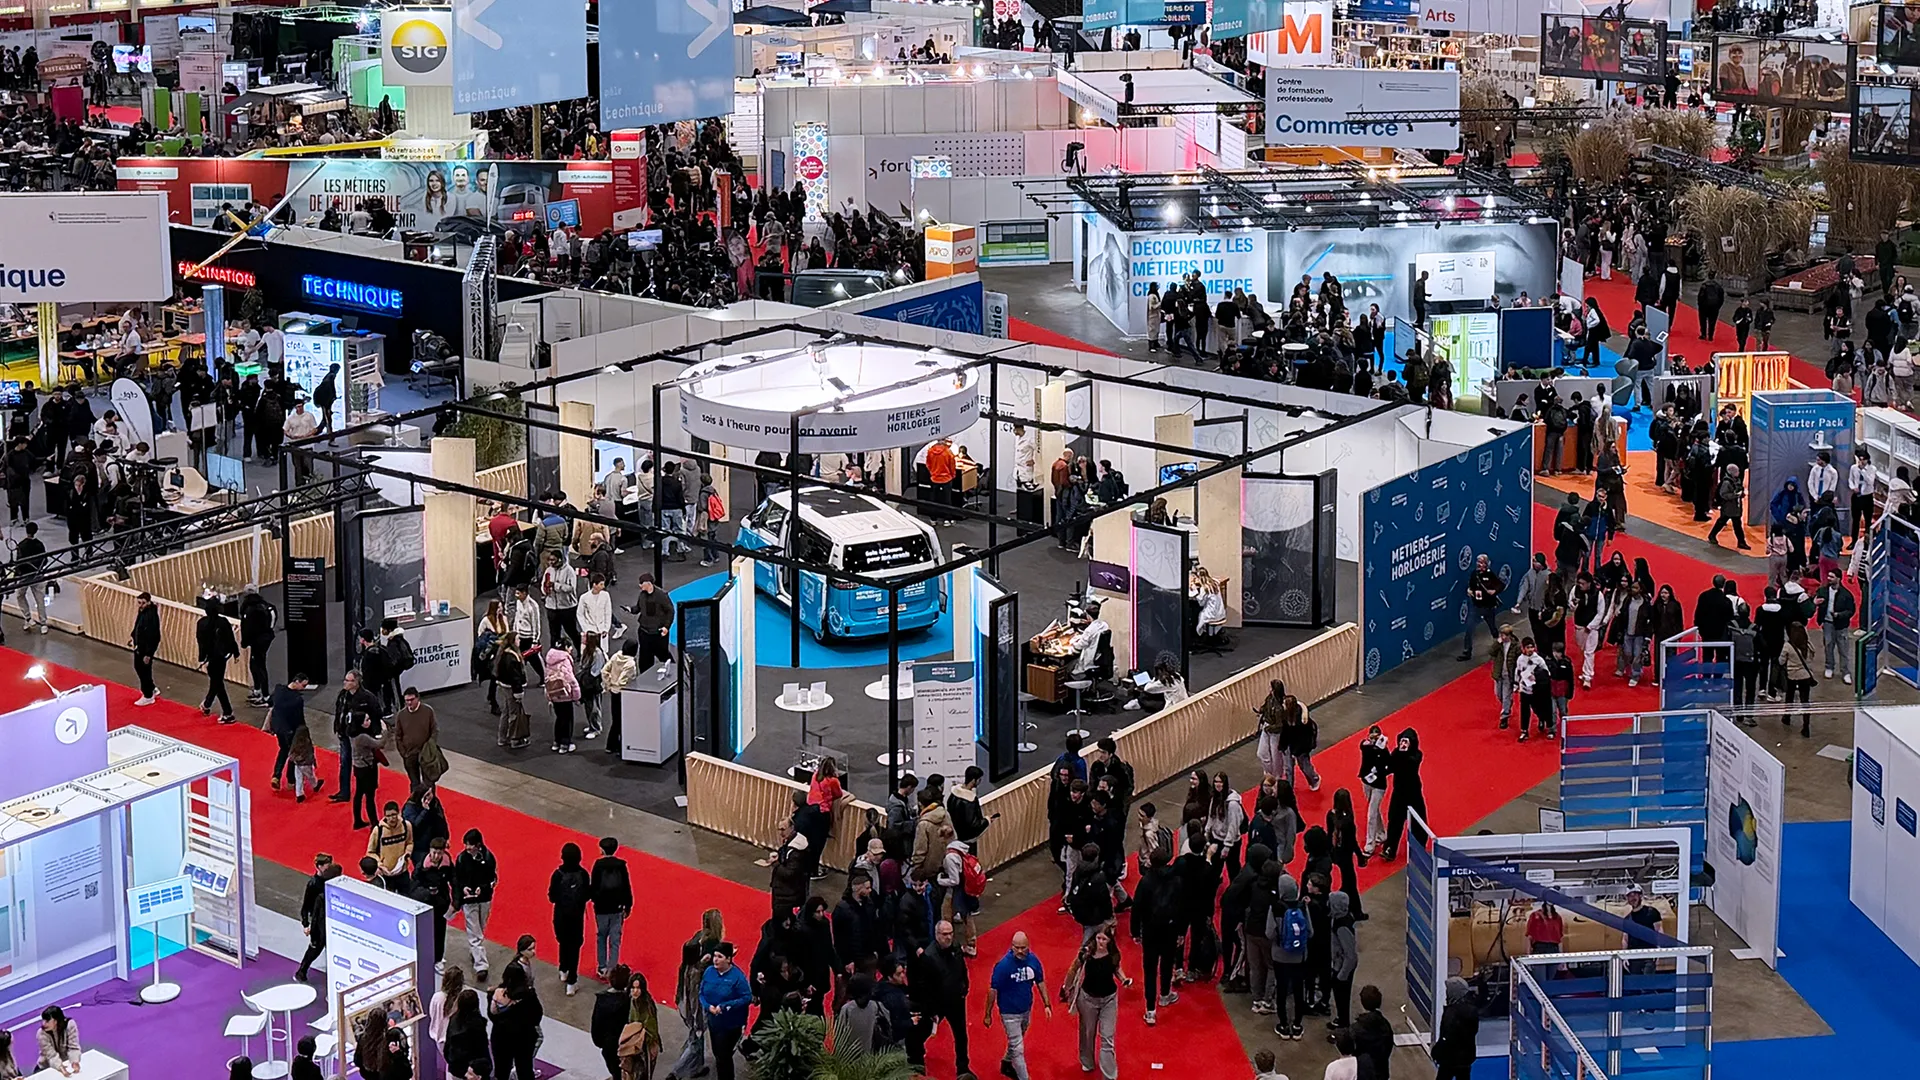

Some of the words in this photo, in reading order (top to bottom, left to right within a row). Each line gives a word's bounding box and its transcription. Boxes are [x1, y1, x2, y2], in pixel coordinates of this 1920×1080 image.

[1425, 8, 1455, 23] Arts
[1278, 14, 1322, 54] M
[401, 46, 439, 59] SIG
[44, 63, 82, 74] RESTAURANT
[1277, 78, 1302, 86] Centre
[1277, 86, 1287, 94] de
[1288, 86, 1325, 95] formation
[457, 87, 517, 104] technique
[1276, 95, 1334, 104] professionnelle
[604, 101, 664, 121] technique
[1275, 114, 1399, 137] Commerce
[324, 179, 342, 193] LES
[344, 176, 387, 193] MÉTIERS
[309, 194, 323, 212] DE
[1132, 238, 1222, 257] DÉCOUVREZ
[1226, 237, 1254, 253] LES
[178, 262, 256, 287] FASCINATION
[1132, 258, 1199, 277] MÉTIERS
[1203, 259, 1224, 274] DU
[0, 263, 66, 293] ique
[303, 276, 402, 309] TECHNIQUE
[887, 407, 926, 422] METIERS
[1778, 418, 1814, 429] Starter
[1818, 417, 1844, 427] Pack
[702, 414, 716, 425] sois
[719, 416, 724, 426] à
[726, 419, 761, 433] l'heure
[764, 425, 790, 436] pour
[799, 428, 815, 437] on
[819, 425, 858, 437] avenir
[887, 416, 941, 433] HORLOGERIE
[928, 425, 941, 437] .CH
[1391, 534, 1430, 564] METIERS
[1391, 544, 1446, 581] HORLOGERIE
[1430, 560, 1446, 580] .CH
[412, 643, 444, 656] ETIERS
[412, 649, 460, 665] ORLOGERIE
[446, 659, 460, 667] .CH
